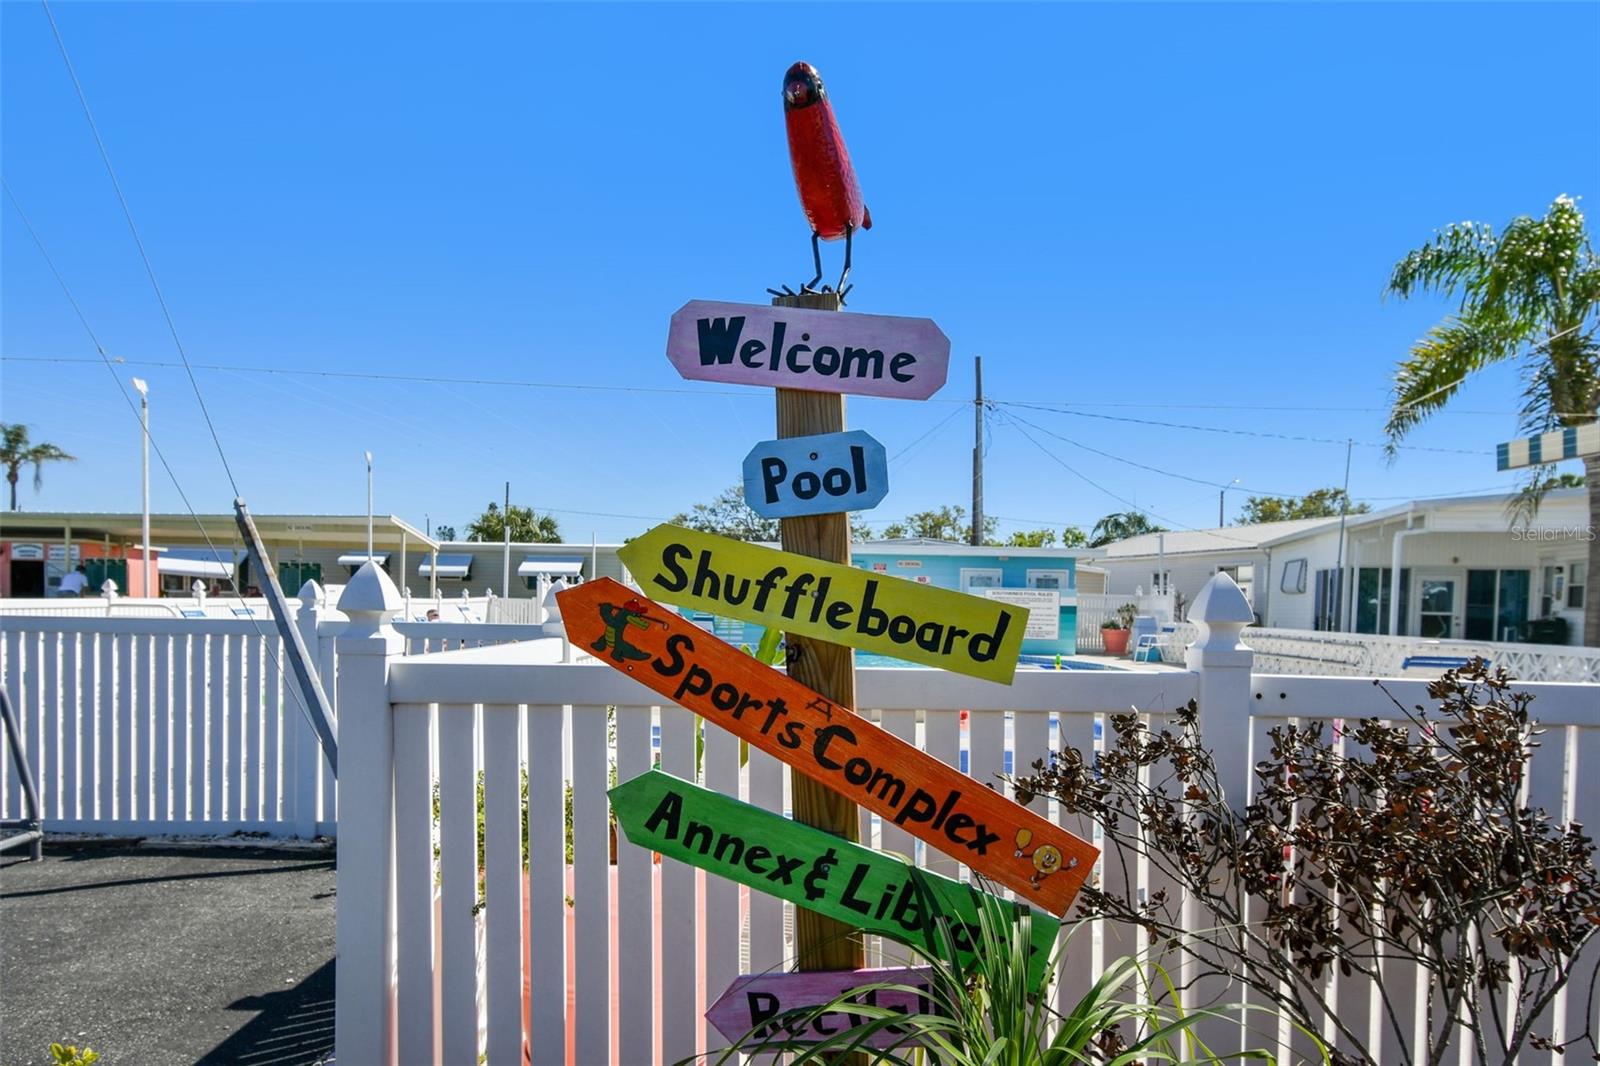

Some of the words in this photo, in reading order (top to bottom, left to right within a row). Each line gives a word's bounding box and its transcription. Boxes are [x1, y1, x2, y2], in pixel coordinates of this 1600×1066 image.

[697, 316, 917, 383] Welcome
[761, 446, 867, 504] Pool
[652, 543, 1011, 663] Shuffleboard
[651, 634, 805, 750] Sports
[813, 724, 1001, 856] Complex
[644, 790, 805, 886] Annex
[803, 848, 838, 901] &
[840, 864, 1038, 975] Libra
